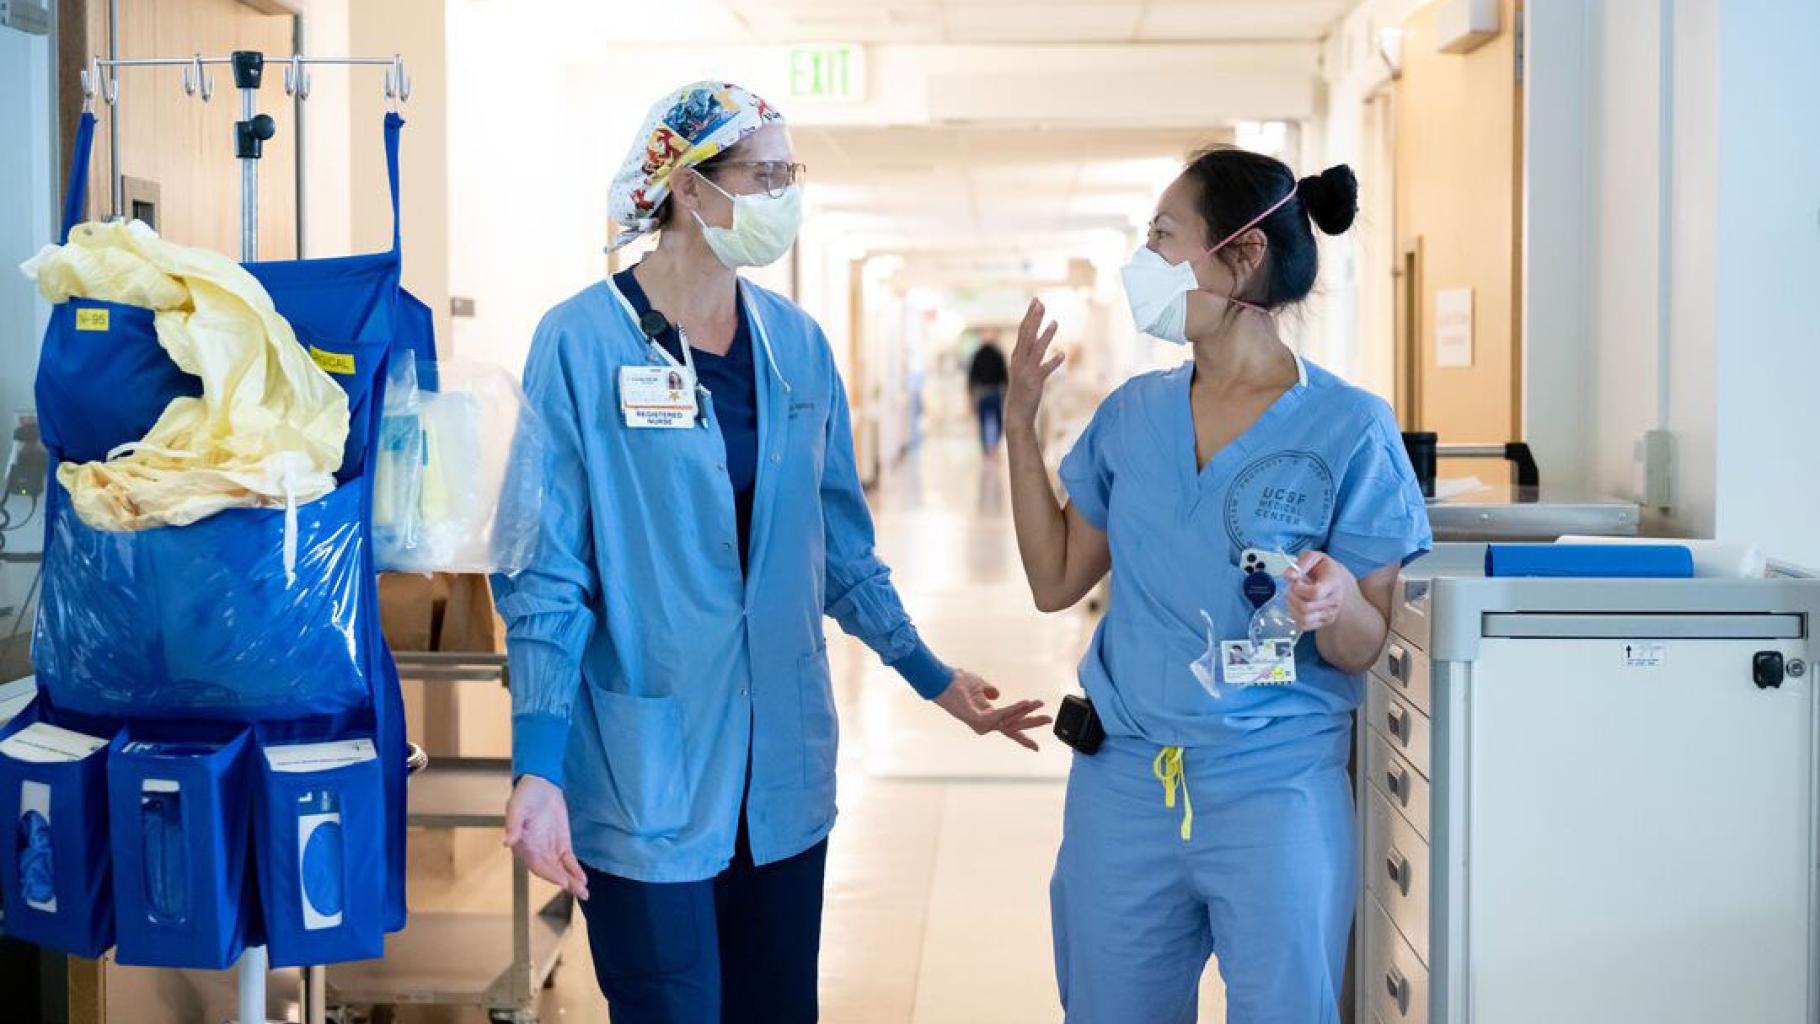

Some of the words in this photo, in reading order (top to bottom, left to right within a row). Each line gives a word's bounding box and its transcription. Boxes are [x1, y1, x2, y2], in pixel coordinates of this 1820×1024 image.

[790, 48, 850, 97] EXIT
[636, 411, 683, 419] REGISTERED
[1262, 486, 1307, 505] UCSF
[1255, 508, 1301, 525] CENTER
[1259, 500, 1301, 516] MEDICAL
